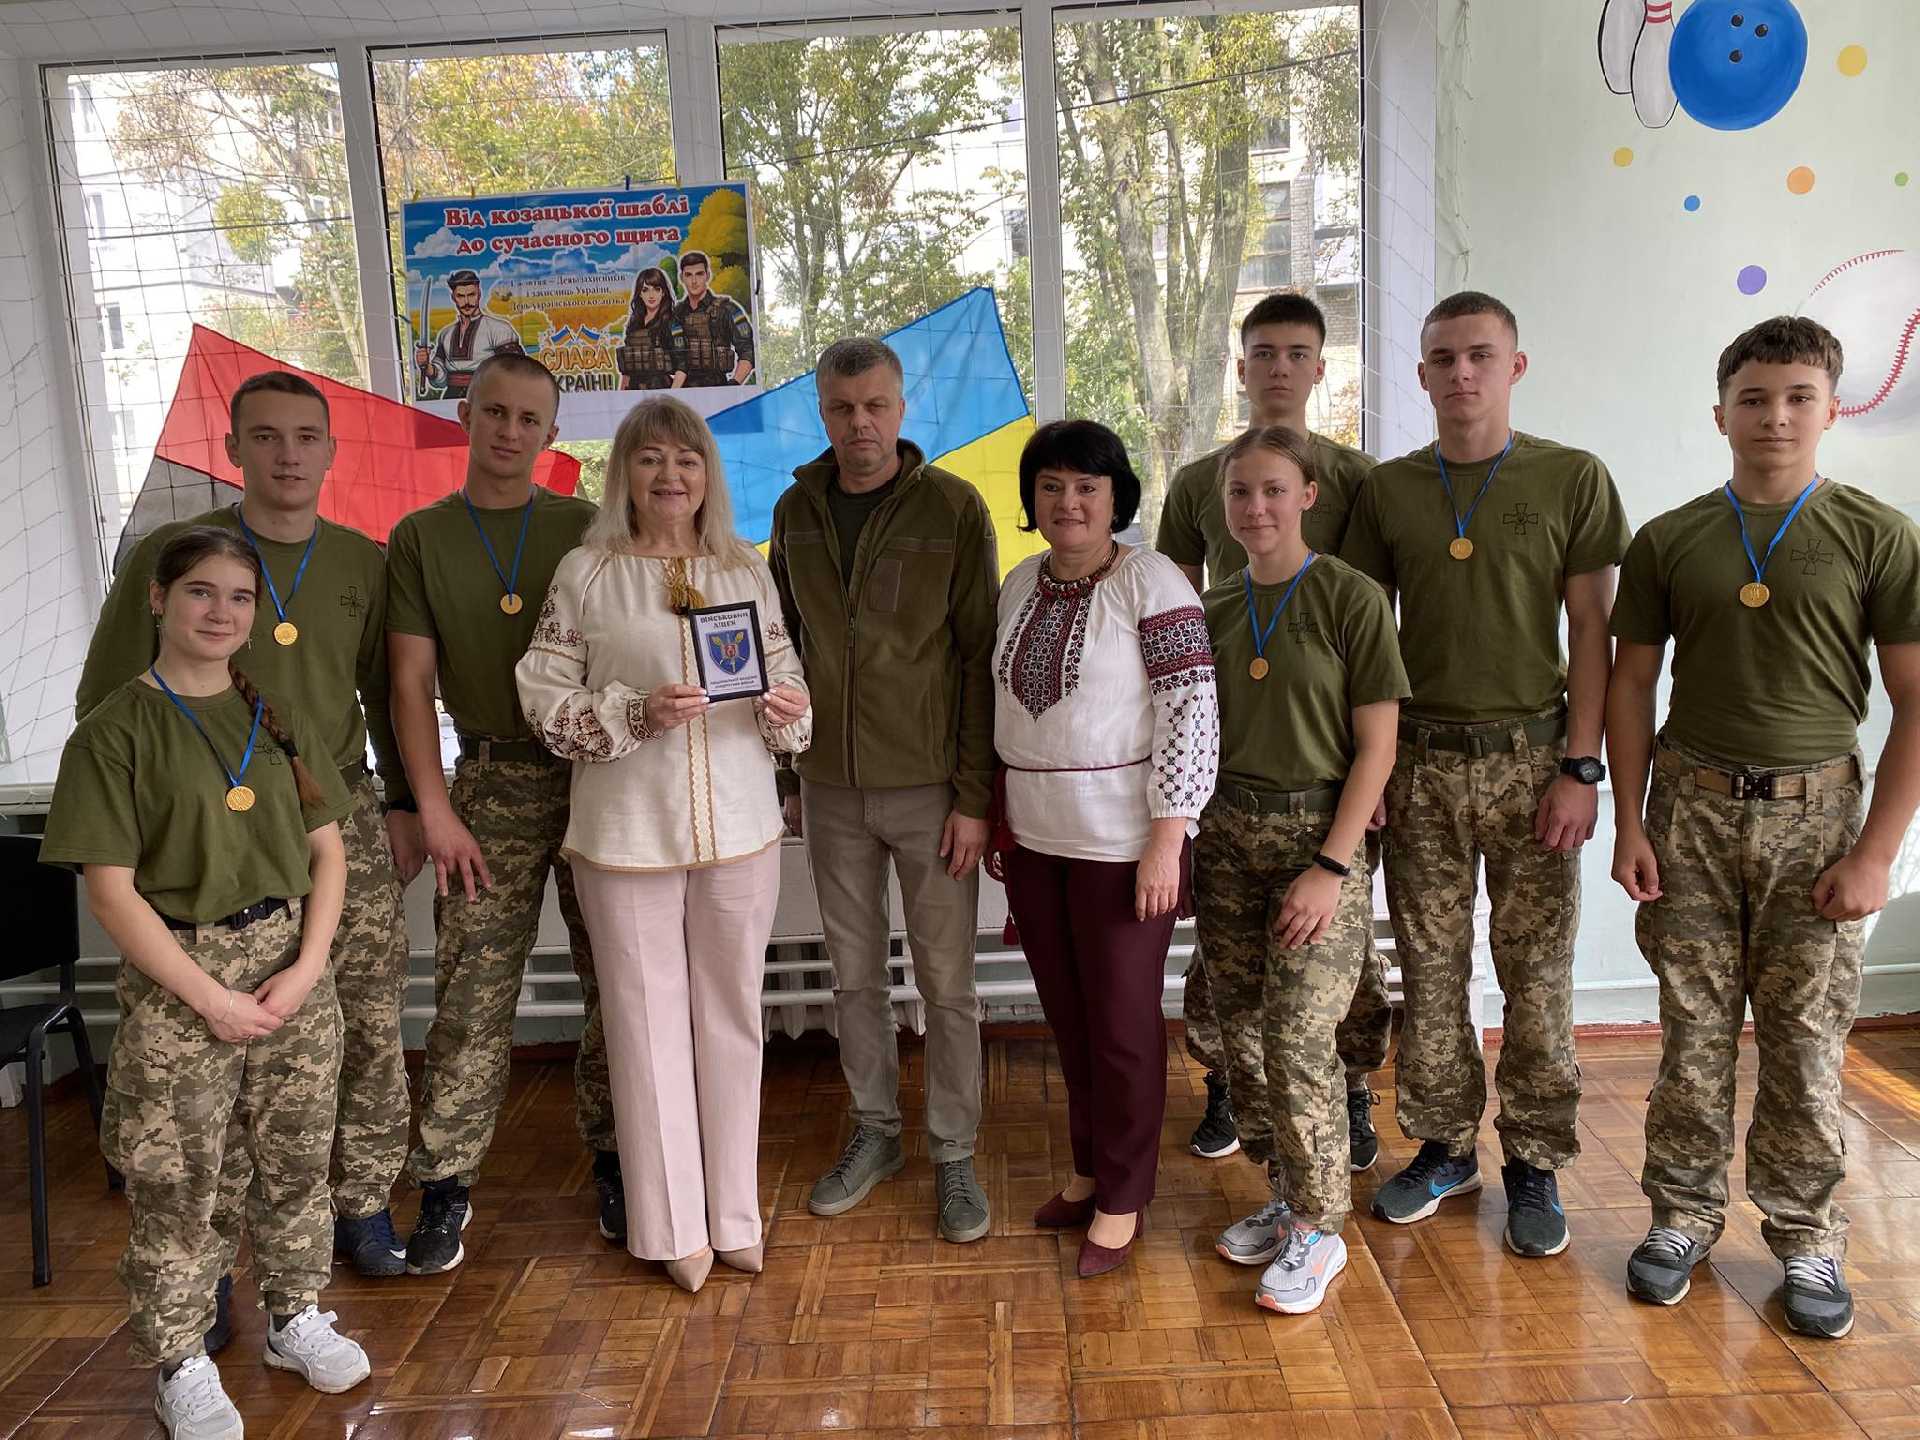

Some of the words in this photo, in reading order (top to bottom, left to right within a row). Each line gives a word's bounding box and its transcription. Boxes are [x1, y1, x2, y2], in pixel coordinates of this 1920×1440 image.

[445, 209, 484, 227] Від
[491, 200, 612, 223] козацької
[617, 195, 688, 216] шаблі
[457, 239, 485, 255] до
[492, 230, 609, 252] сучасного
[616, 228, 679, 245] щита
[539, 345, 613, 370] СЛАВА
[555, 371, 613, 392] КРАЇНІ!
